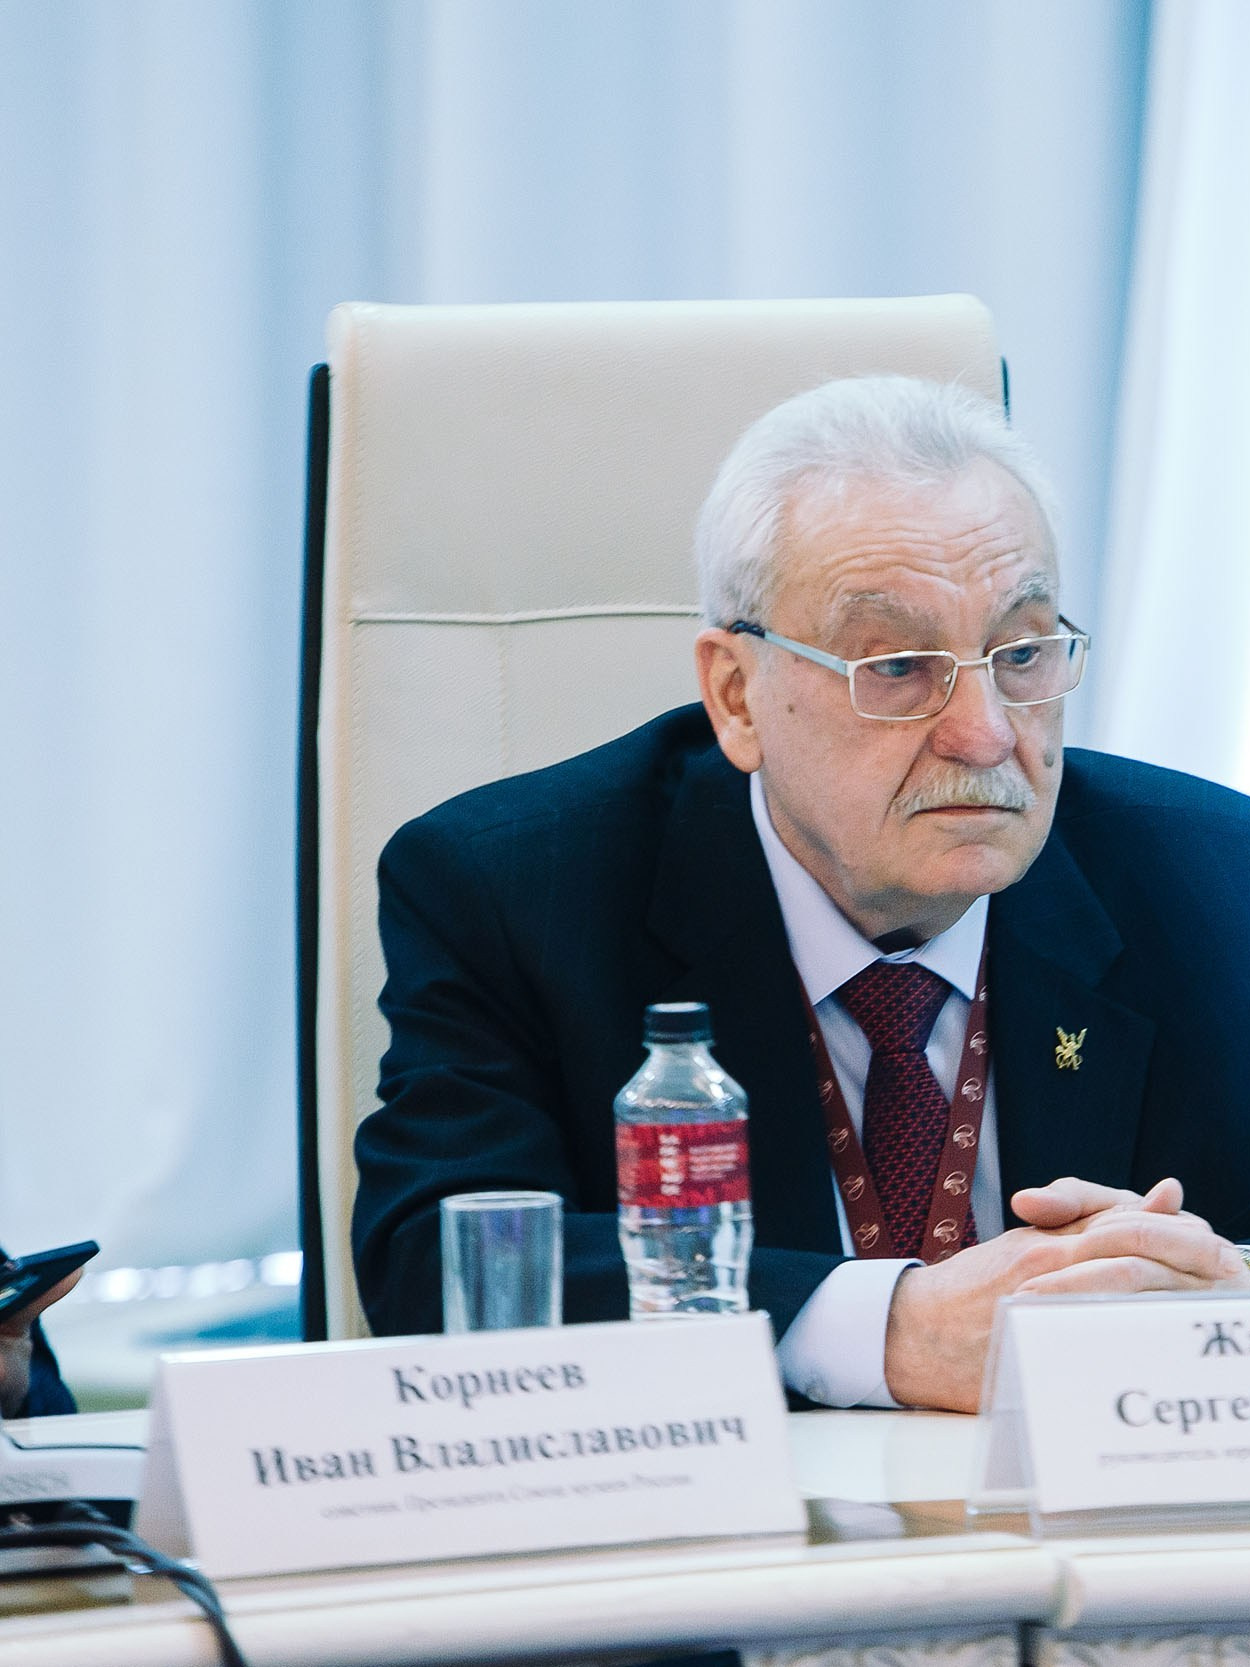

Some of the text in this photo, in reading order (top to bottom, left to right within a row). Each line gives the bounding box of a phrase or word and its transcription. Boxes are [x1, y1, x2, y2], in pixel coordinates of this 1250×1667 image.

[389, 1360, 588, 1408] Корнеев
[250, 1414, 749, 1488] Иван Владиславович
